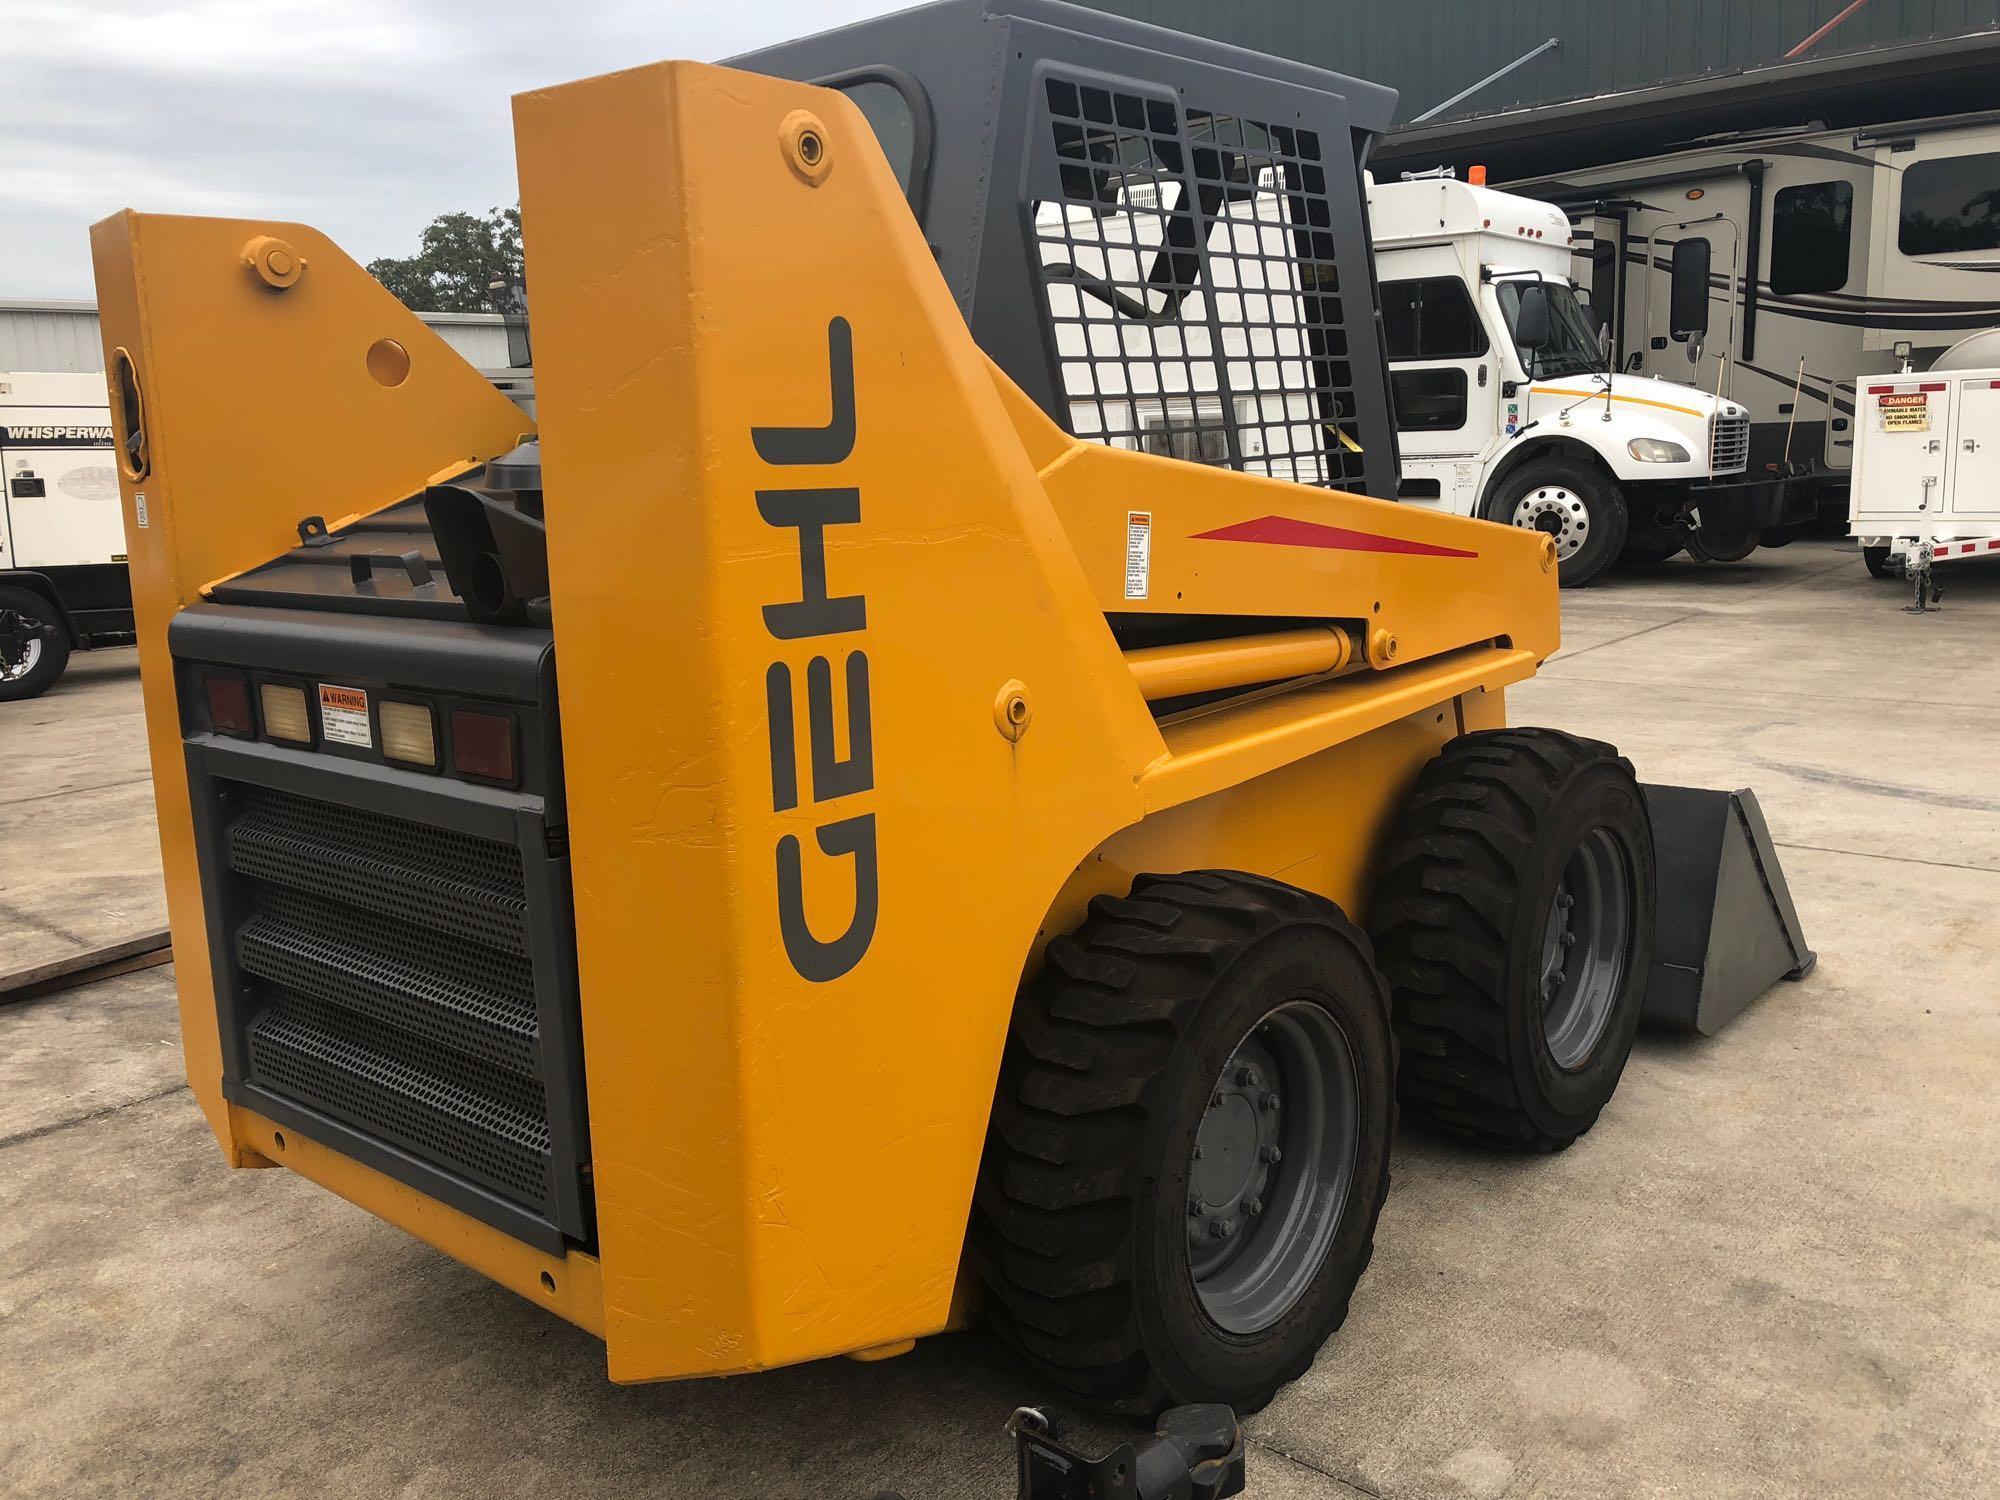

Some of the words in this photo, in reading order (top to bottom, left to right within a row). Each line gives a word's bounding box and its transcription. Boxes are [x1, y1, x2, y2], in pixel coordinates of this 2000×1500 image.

[1888, 396, 1924, 404] DANGER
[751, 315, 879, 982] GEHL
[329, 693, 365, 707] WARNING
